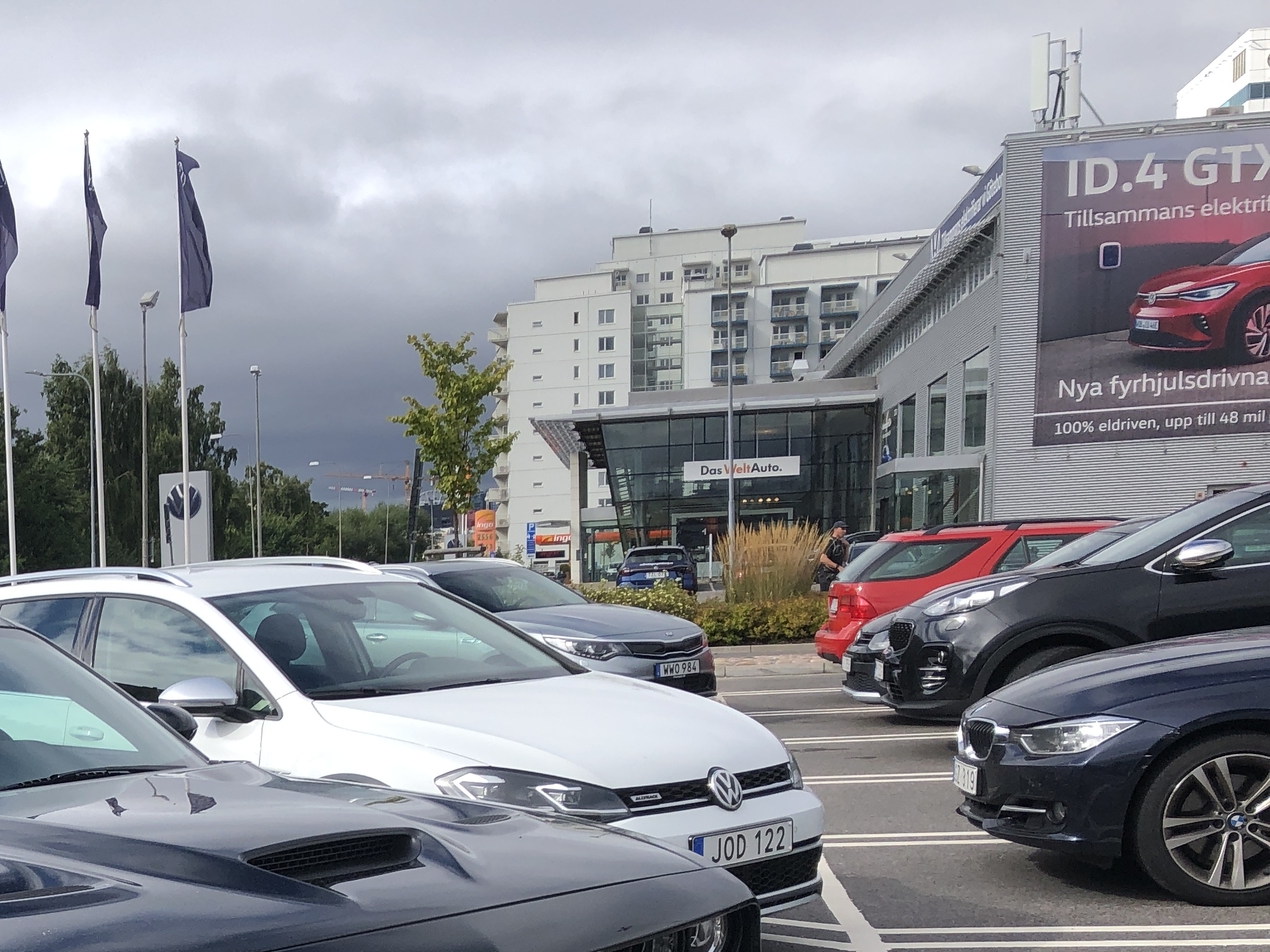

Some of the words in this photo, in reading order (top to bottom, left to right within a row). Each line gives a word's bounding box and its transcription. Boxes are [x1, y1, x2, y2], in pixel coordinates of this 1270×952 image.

[1067, 153, 1168, 197] ID.4
[1064, 203, 1195, 228] Tillsammans
[1058, 379, 1103, 402] Nya
[1109, 368, 1269, 399] fyrhjulsdrivna
[1054, 421, 1095, 435] 100%
[1098, 417, 1161, 431] eldriven,
[1165, 415, 1193, 430] upp
[1197, 413, 1216, 426] till
[1220, 411, 1239, 424] 48
[1243, 410, 1266, 423] mil
[700, 465, 722, 476] Das
[682, 662, 697, 673] 984
[711, 834, 746, 864] JOD
[755, 826, 786, 855] 122
